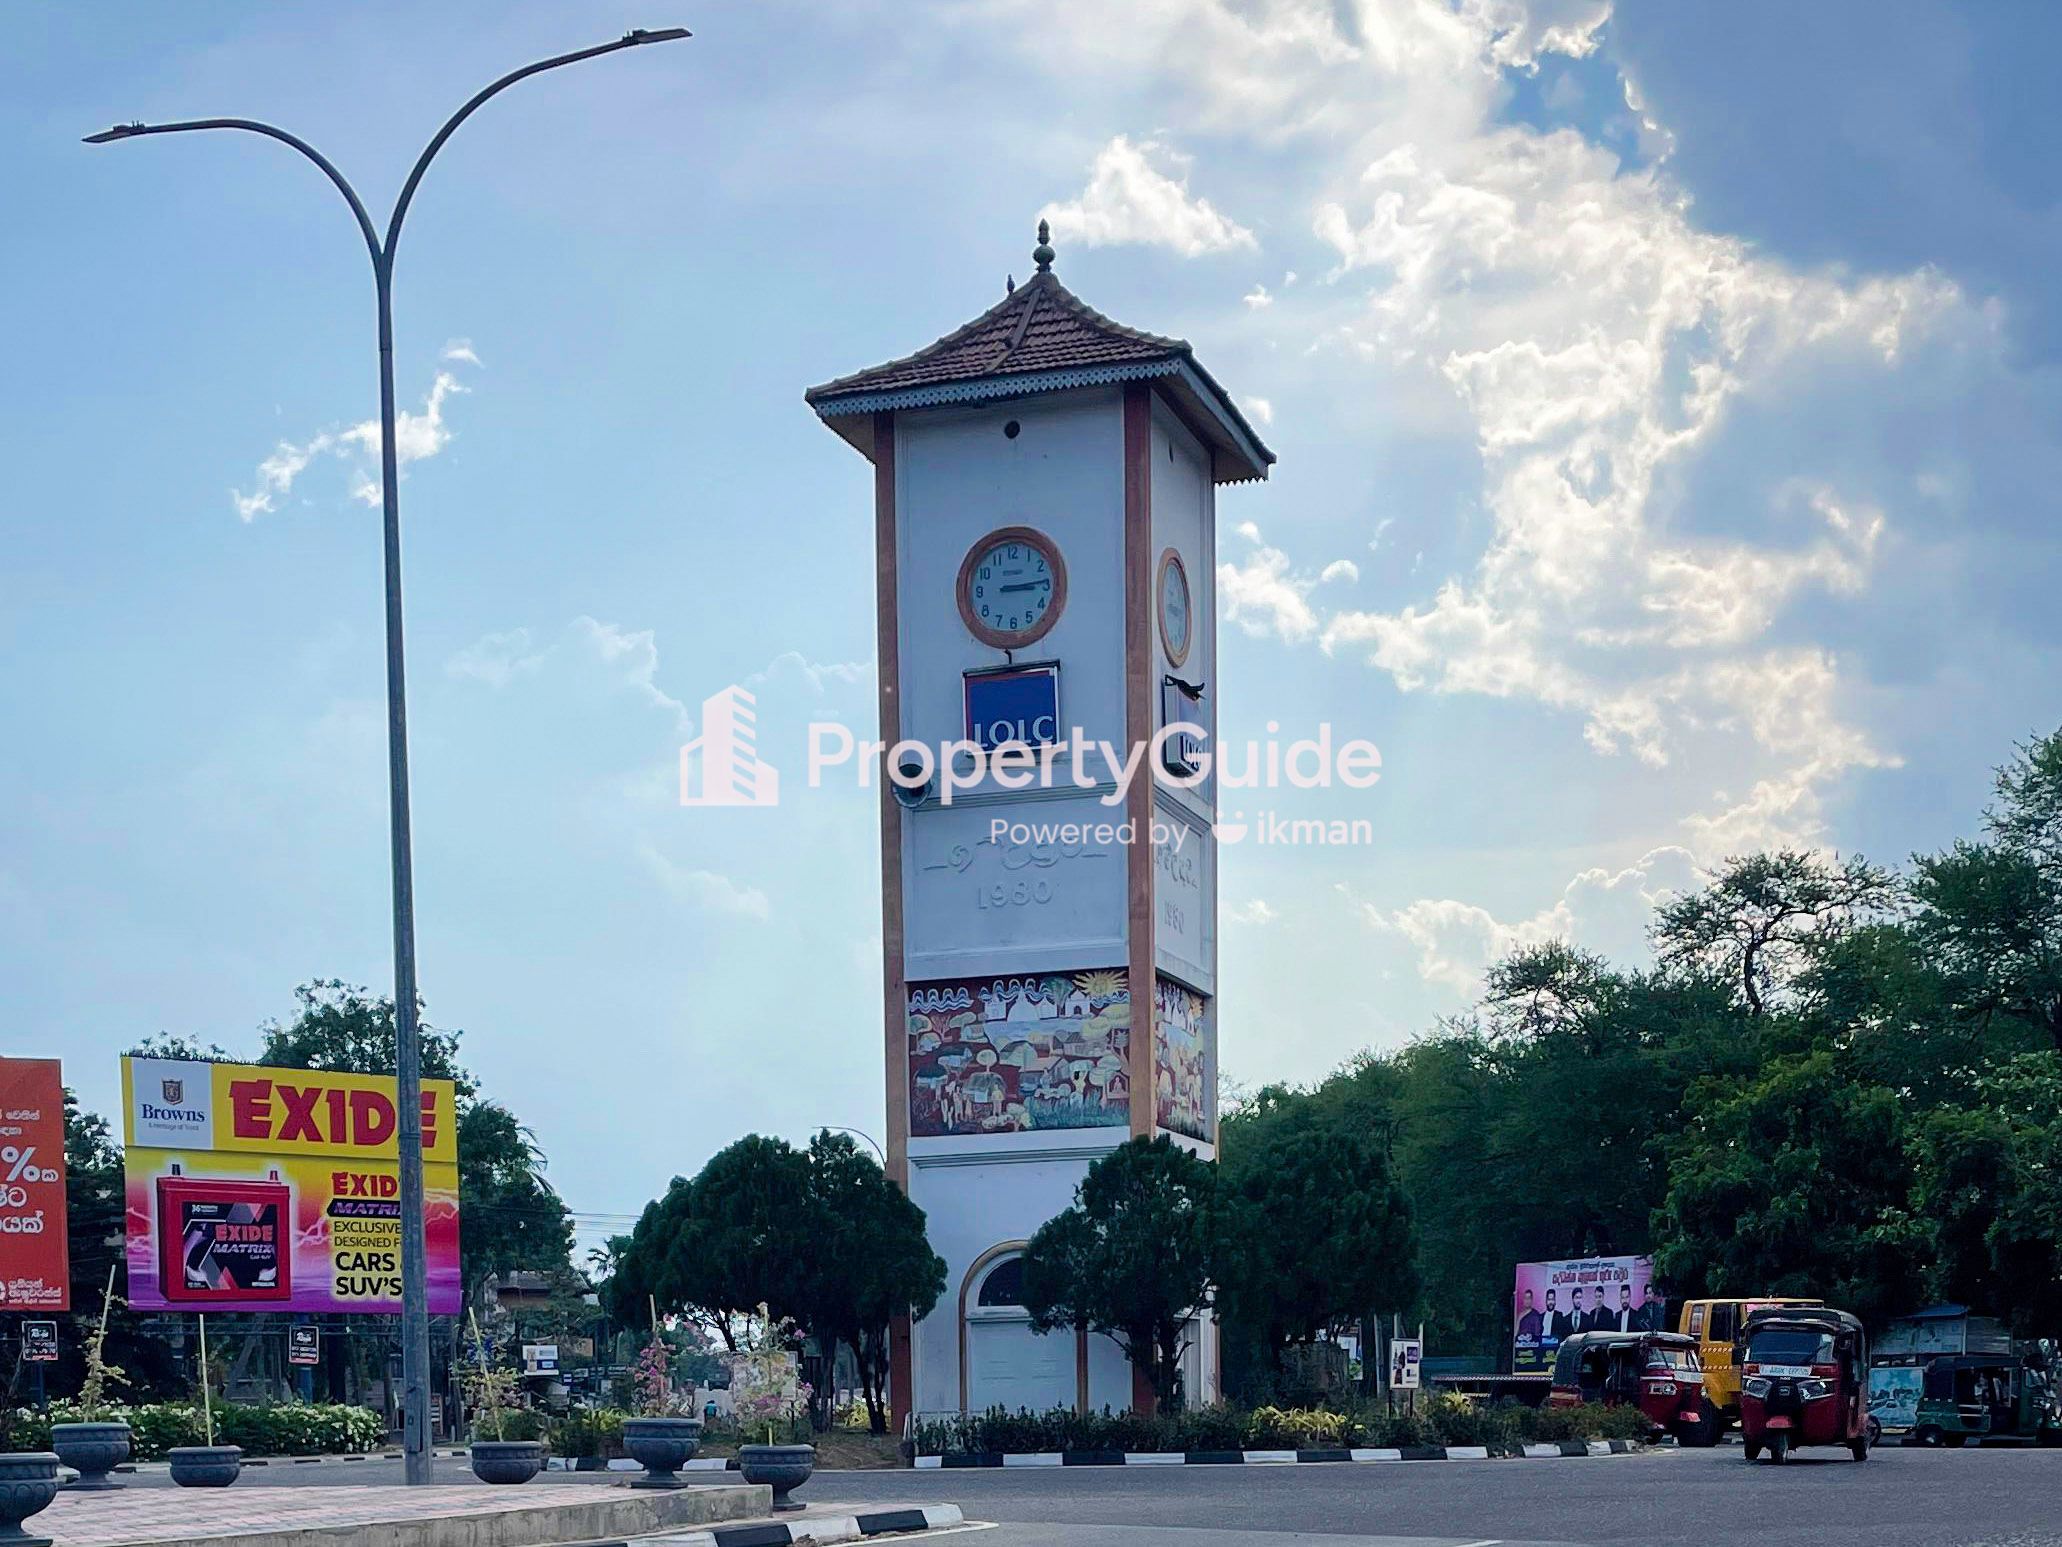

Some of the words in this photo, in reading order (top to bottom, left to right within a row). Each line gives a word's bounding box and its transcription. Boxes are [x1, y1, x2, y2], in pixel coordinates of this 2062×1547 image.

[993, 553, 1002, 566] 11
[1007, 546, 1018, 560] 12
[1037, 560, 1045, 573] 2
[980, 567, 991, 581] 10
[975, 586, 984, 598] 9
[1042, 579, 1051, 592] 3
[1037, 597, 1045, 610] 4
[981, 604, 990, 618] 8
[1025, 611, 1033, 624] 5
[995, 615, 1003, 628] 7
[1009, 617, 1018, 630] 6
[974, 715, 1053, 747] LOLC
[142, 1103, 205, 1123] Browns
[331, 1172, 398, 1198] EXID
[334, 1202, 401, 1216] MATRI
[215, 1224, 273, 1241] EXIDE
[213, 1243, 273, 1253] MATRIX
[334, 1236, 392, 1247] DESIGNED
[335, 1252, 395, 1272] CARS
